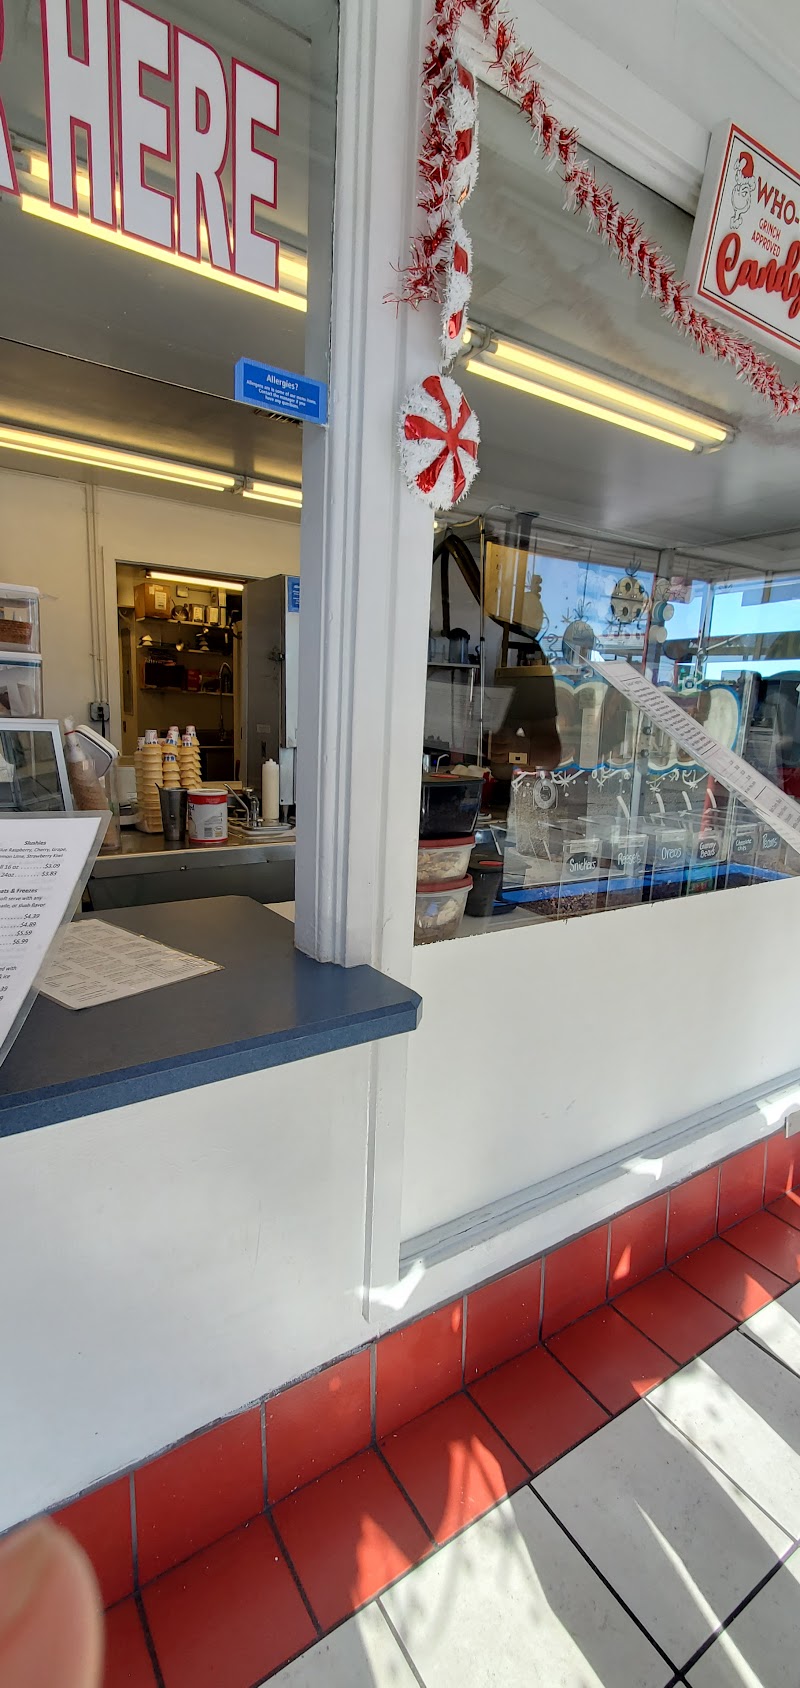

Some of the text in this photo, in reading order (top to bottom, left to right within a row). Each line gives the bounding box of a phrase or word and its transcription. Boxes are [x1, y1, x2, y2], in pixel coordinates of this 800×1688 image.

[40, 0, 280, 293] HERE
[758, 217, 781, 241] GRINCH
[751, 230, 781, 258] APPROVED
[715, 232, 800, 319] Candy
[265, 374, 299, 391] Allergies?
[661, 847, 682, 860] Oreos
[700, 841, 717, 851] Gummy
[700, 847, 716, 858] Bears
